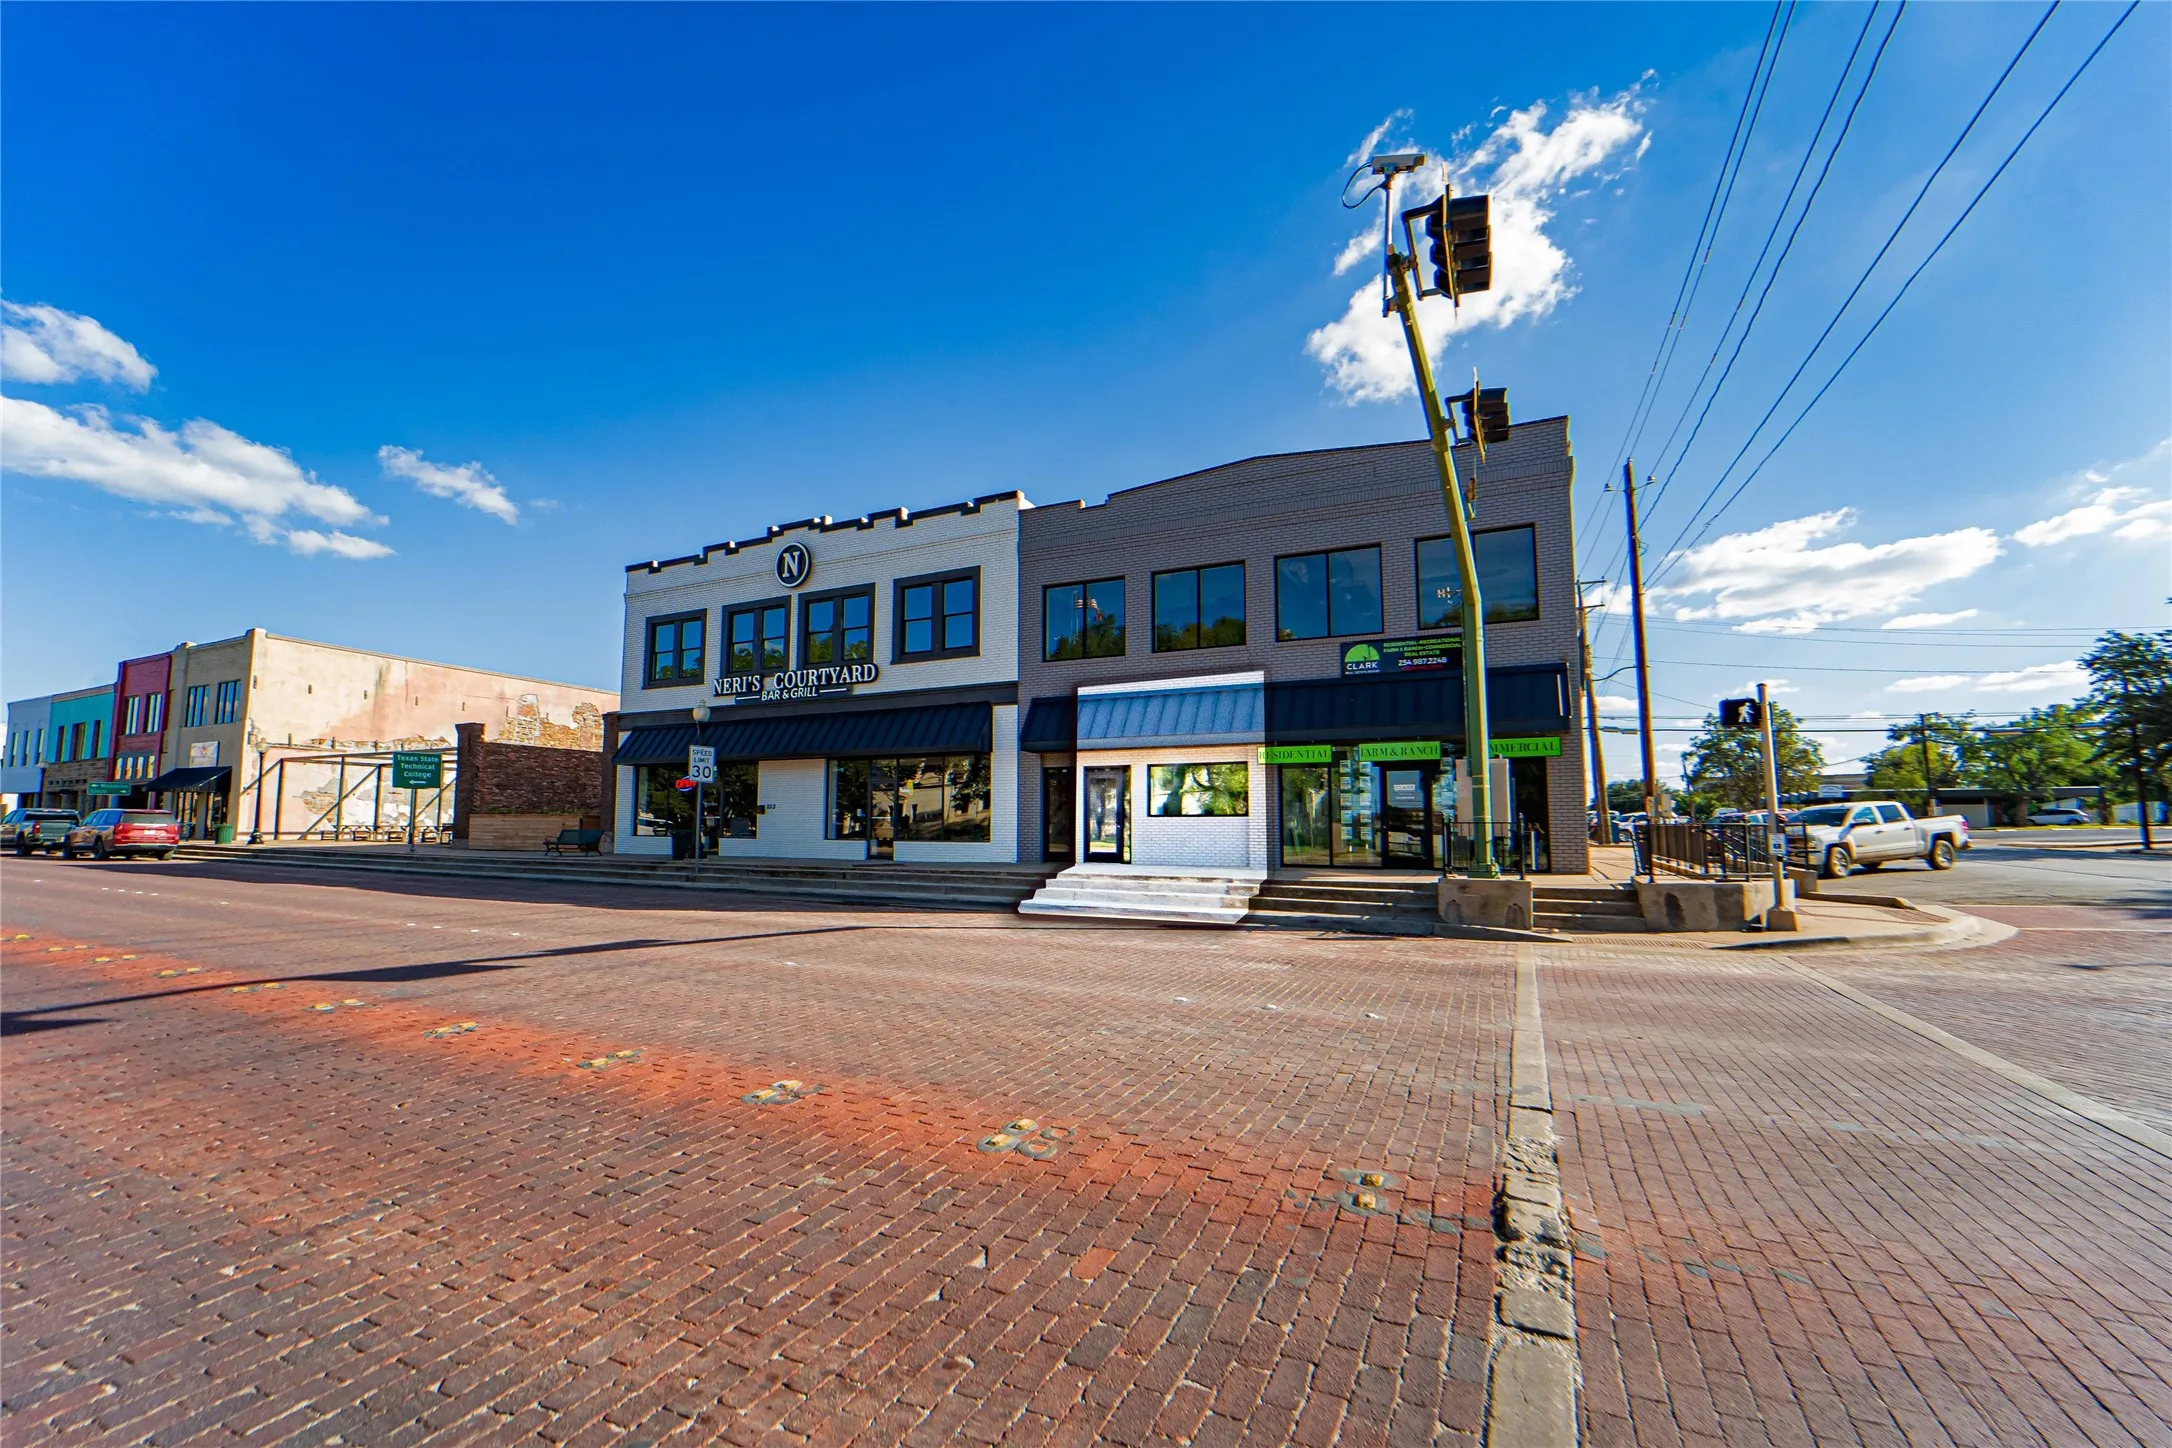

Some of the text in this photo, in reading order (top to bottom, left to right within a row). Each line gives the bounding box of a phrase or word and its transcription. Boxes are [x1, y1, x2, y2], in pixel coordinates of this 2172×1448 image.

[782, 551, 800, 578] N
[1346, 661, 1378, 670] CLARK
[713, 664, 876, 695] NERI'S COURTYARD
[761, 686, 818, 701] BAR & GRILL
[1400, 745, 1438, 756] RANCH
[1488, 741, 1557, 752] MMERCIAL
[1259, 749, 1330, 760] RESIDENTIAL
[400, 762, 435, 770] Technical
[692, 765, 712, 778] 30
[403, 771, 432, 779] College
